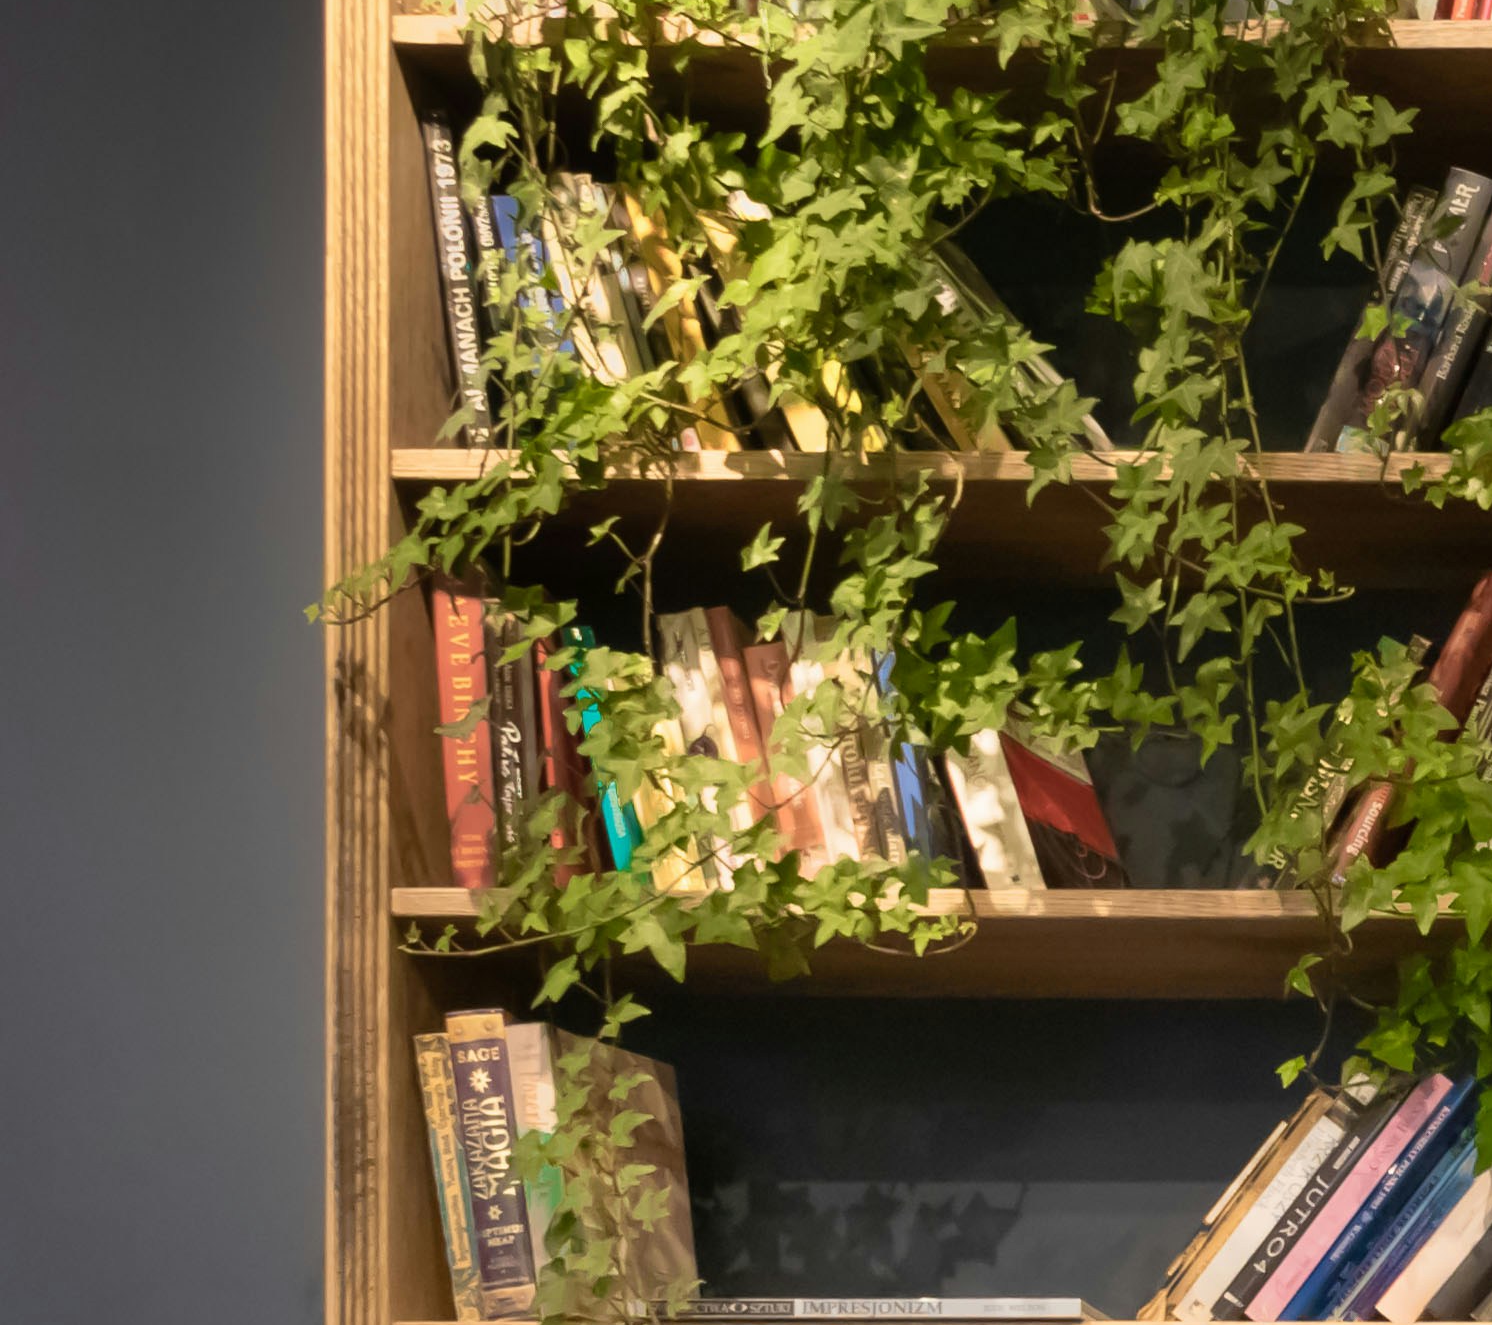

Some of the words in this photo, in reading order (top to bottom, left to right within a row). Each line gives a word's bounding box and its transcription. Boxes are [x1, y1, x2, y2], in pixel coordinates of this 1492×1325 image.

[430, 136, 456, 190] 1973
[439, 194, 470, 282] POLONII
[456, 1043, 502, 1067] SAGE
[460, 1096, 489, 1201] ZAKAZANA
[478, 1093, 515, 1197] MAGIA
[1261, 1172, 1333, 1258] JUTRO
[801, 1299, 944, 1317] IMPRESJONIZM
